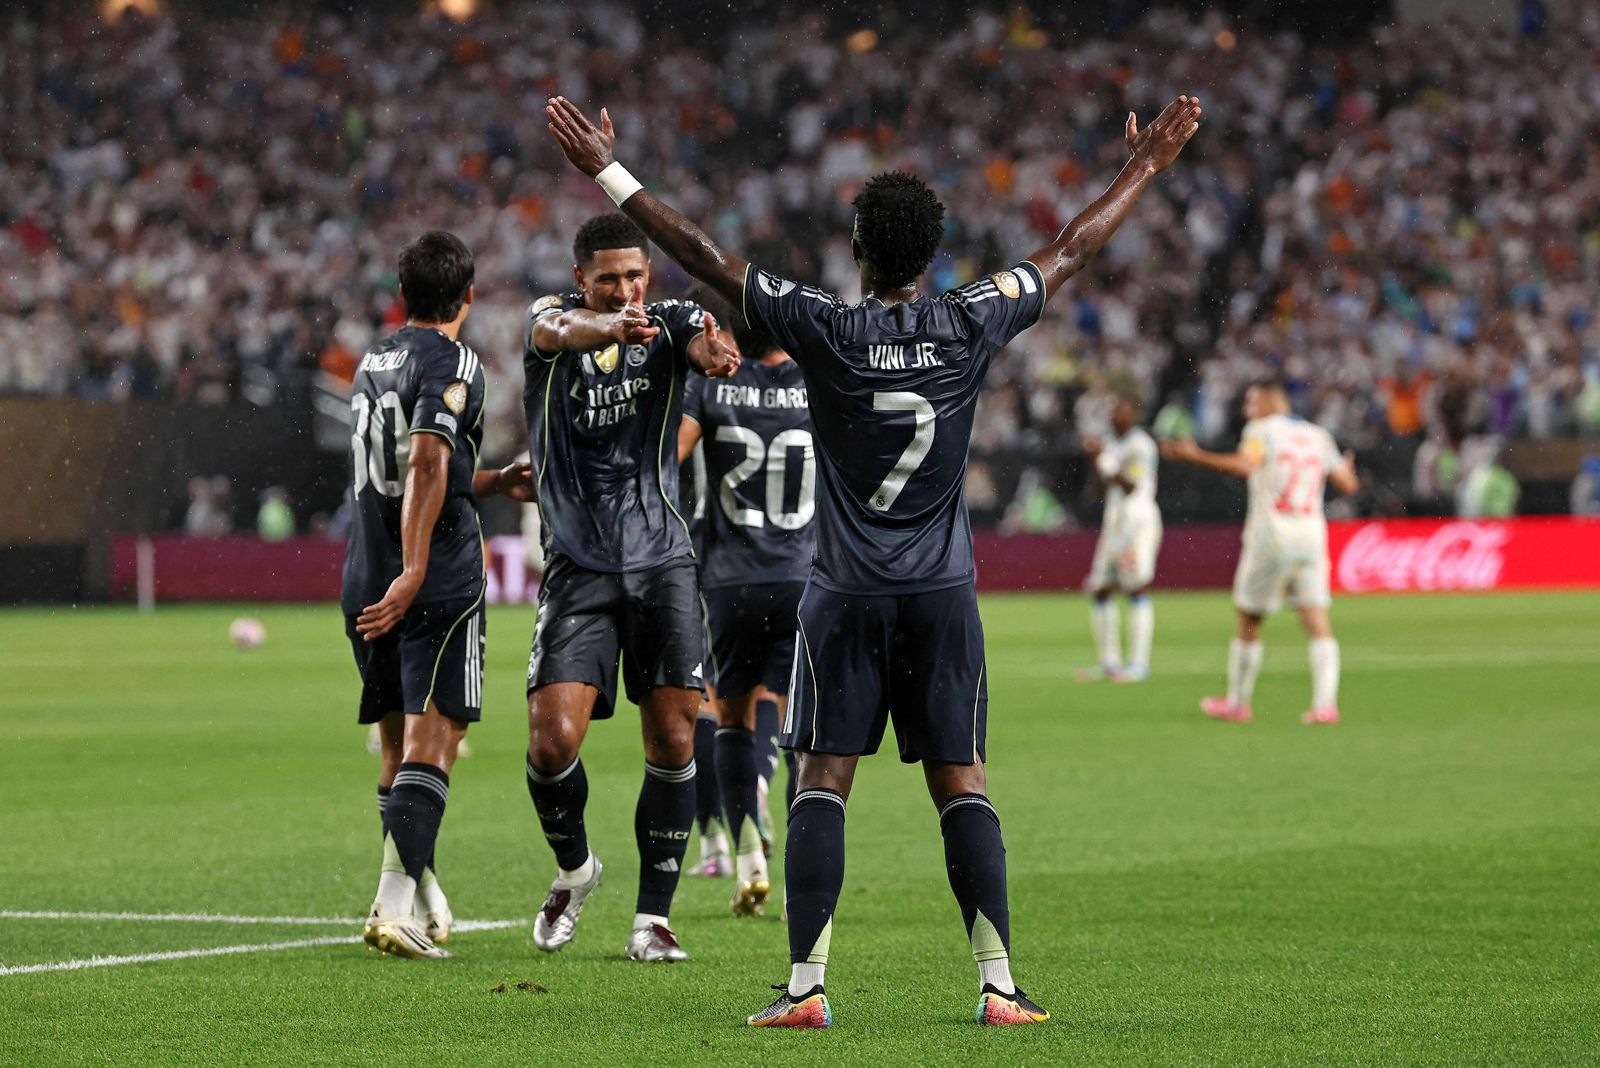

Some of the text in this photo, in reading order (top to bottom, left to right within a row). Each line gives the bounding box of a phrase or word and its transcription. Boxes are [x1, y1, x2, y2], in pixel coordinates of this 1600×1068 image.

[868, 342, 944, 370] VINI JR.
[716, 384, 809, 409] FRAN GARC
[598, 397, 637, 427] BETTR
[866, 391, 936, 512] 7
[715, 425, 817, 530] 20
